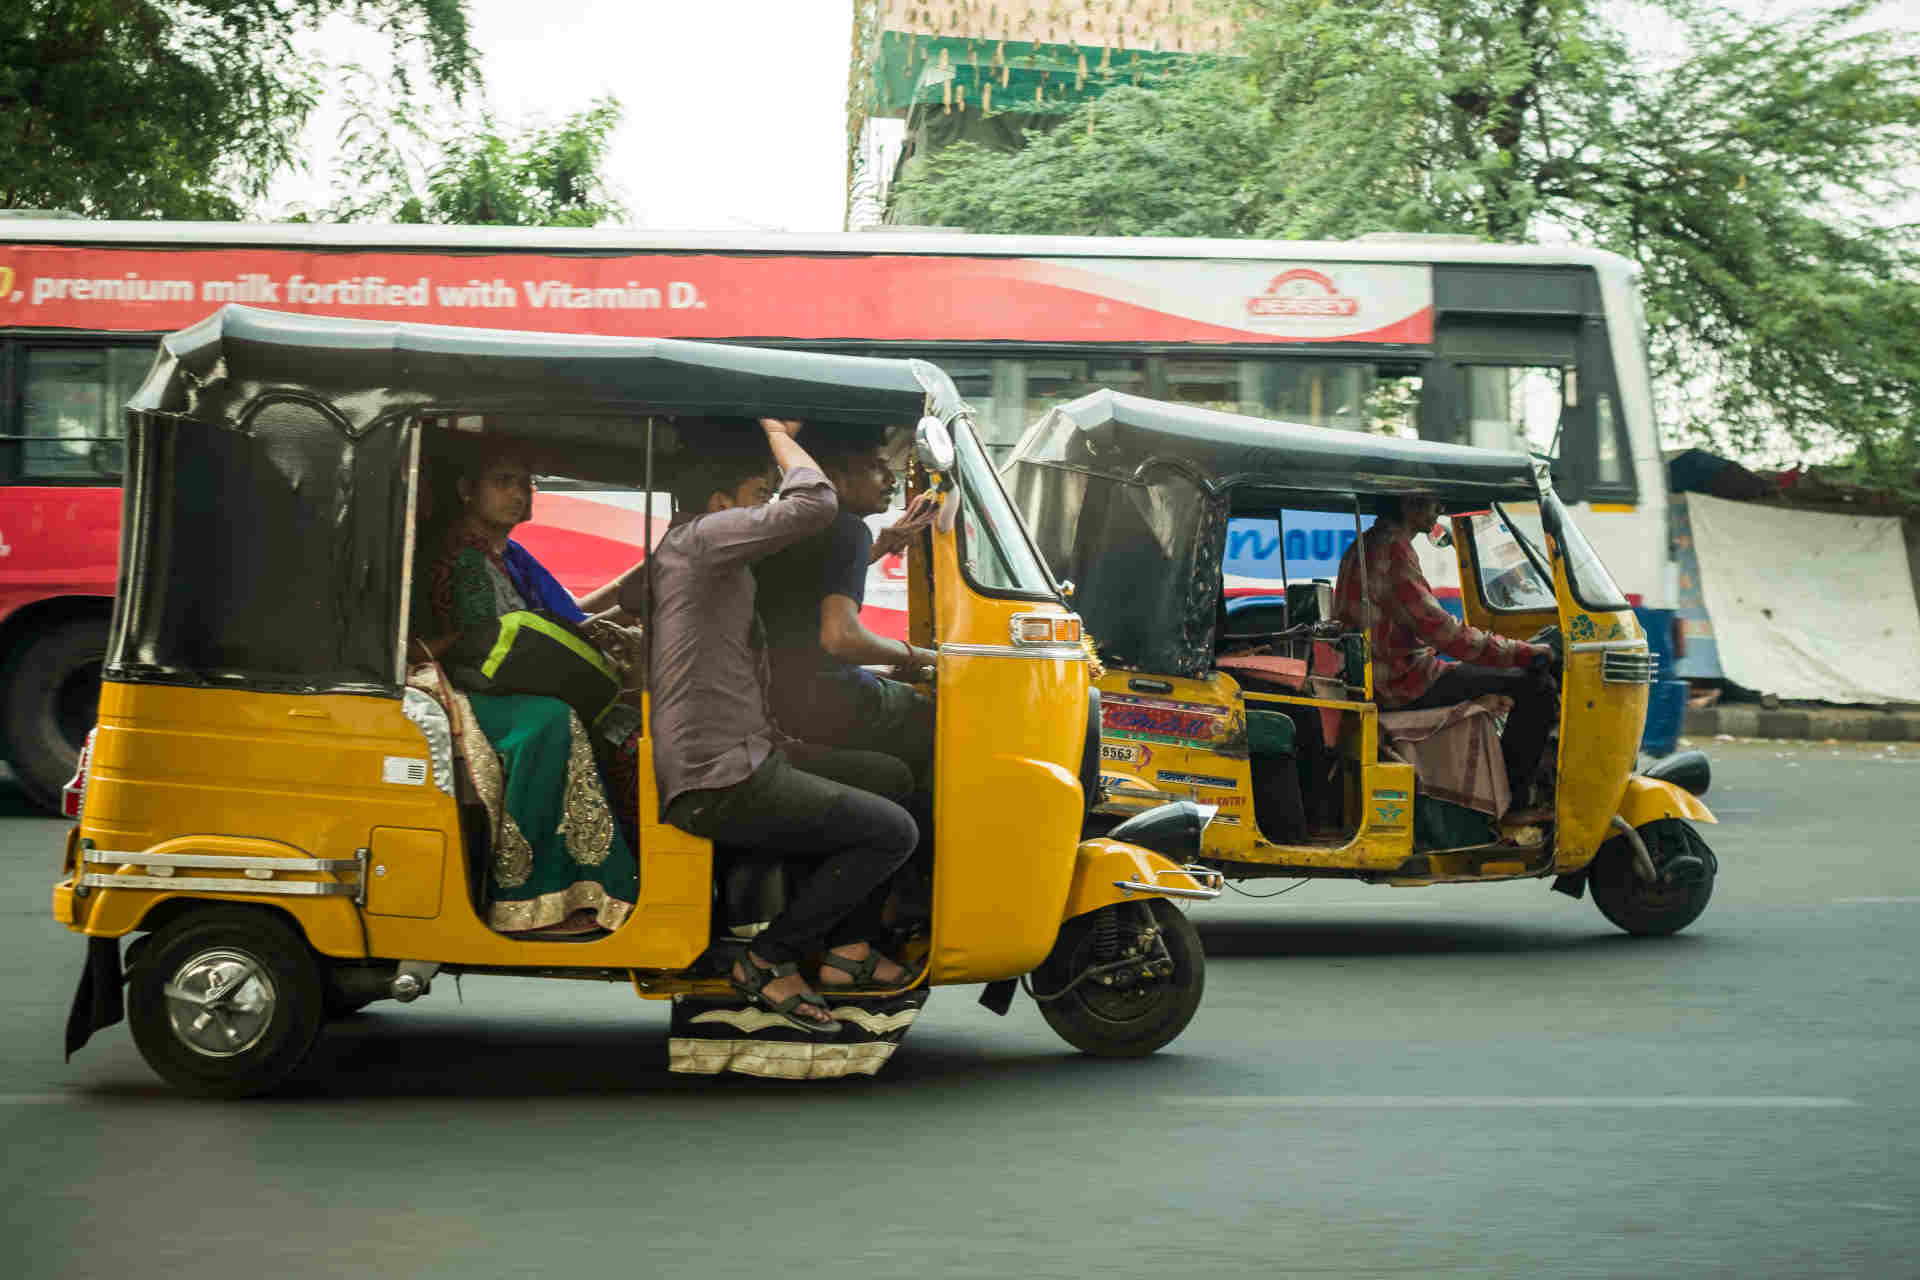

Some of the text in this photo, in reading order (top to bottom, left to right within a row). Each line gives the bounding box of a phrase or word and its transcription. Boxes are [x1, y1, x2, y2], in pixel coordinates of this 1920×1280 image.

[32, 273, 194, 304] premium
[203, 274, 279, 303] milk
[287, 276, 430, 306] fortified
[436, 279, 517, 307] with
[523, 281, 660, 309] Vitamin
[668, 282, 707, 309] D.
